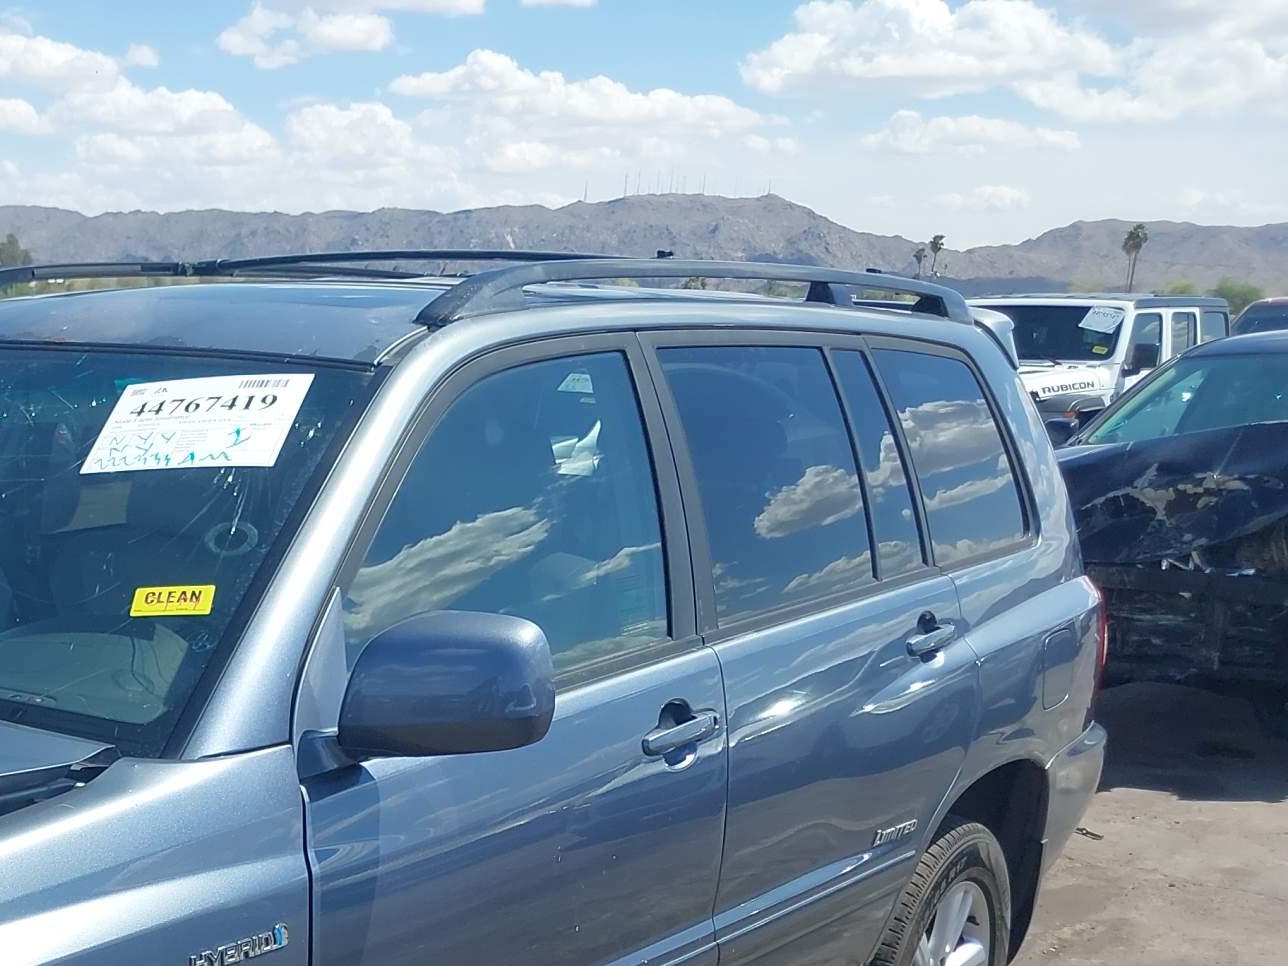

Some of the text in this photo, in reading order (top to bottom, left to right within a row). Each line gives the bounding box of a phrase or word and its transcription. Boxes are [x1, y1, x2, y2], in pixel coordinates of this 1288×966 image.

[1041, 381, 1095, 394] RUBICON
[130, 394, 278, 417] 44767419
[144, 590, 203, 605] CLEAN
